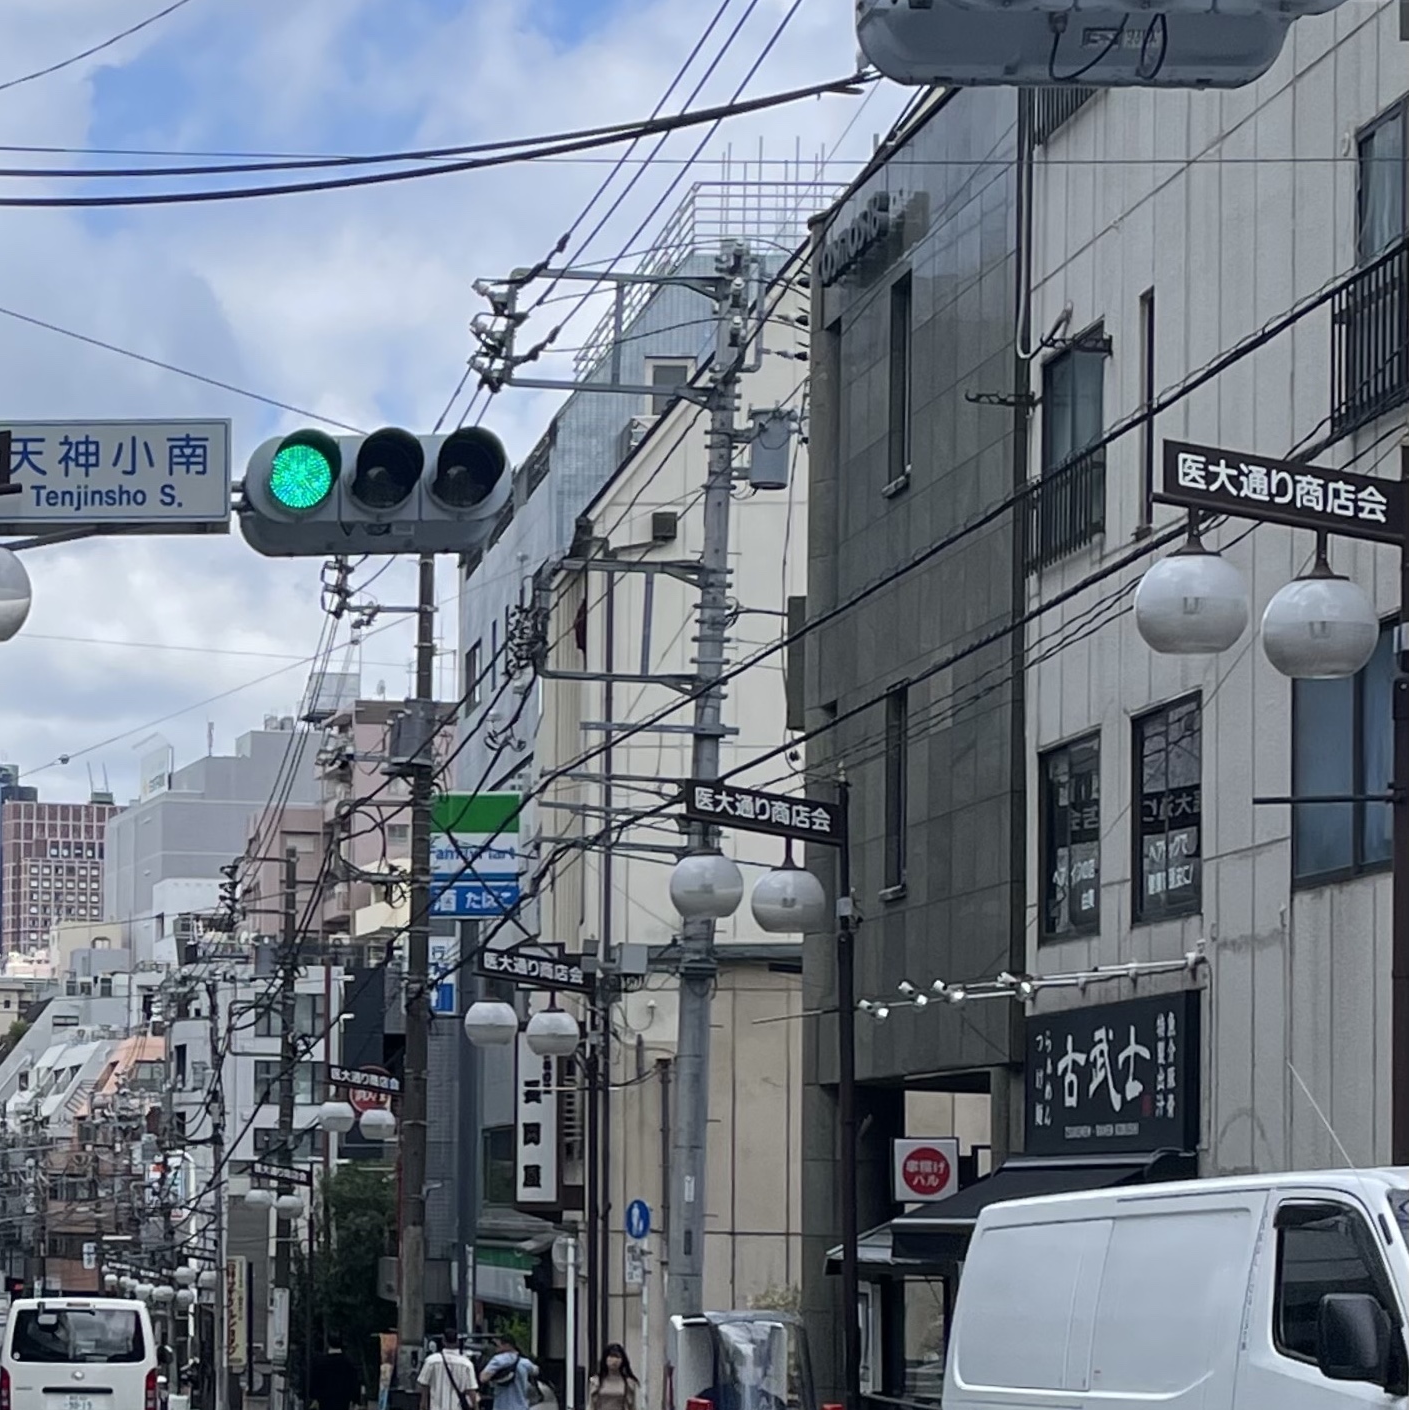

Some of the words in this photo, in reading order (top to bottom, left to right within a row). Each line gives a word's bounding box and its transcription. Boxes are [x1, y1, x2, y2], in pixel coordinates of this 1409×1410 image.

[10, 433, 209, 478] 天神小南
[30, 484, 147, 511] Tenjinsho
[159, 484, 183, 508] S.
[1177, 452, 1387, 523] 医大通り商店会
[694, 786, 831, 832] 医大通り商店会
[483, 951, 584, 984] 医大通り商店会
